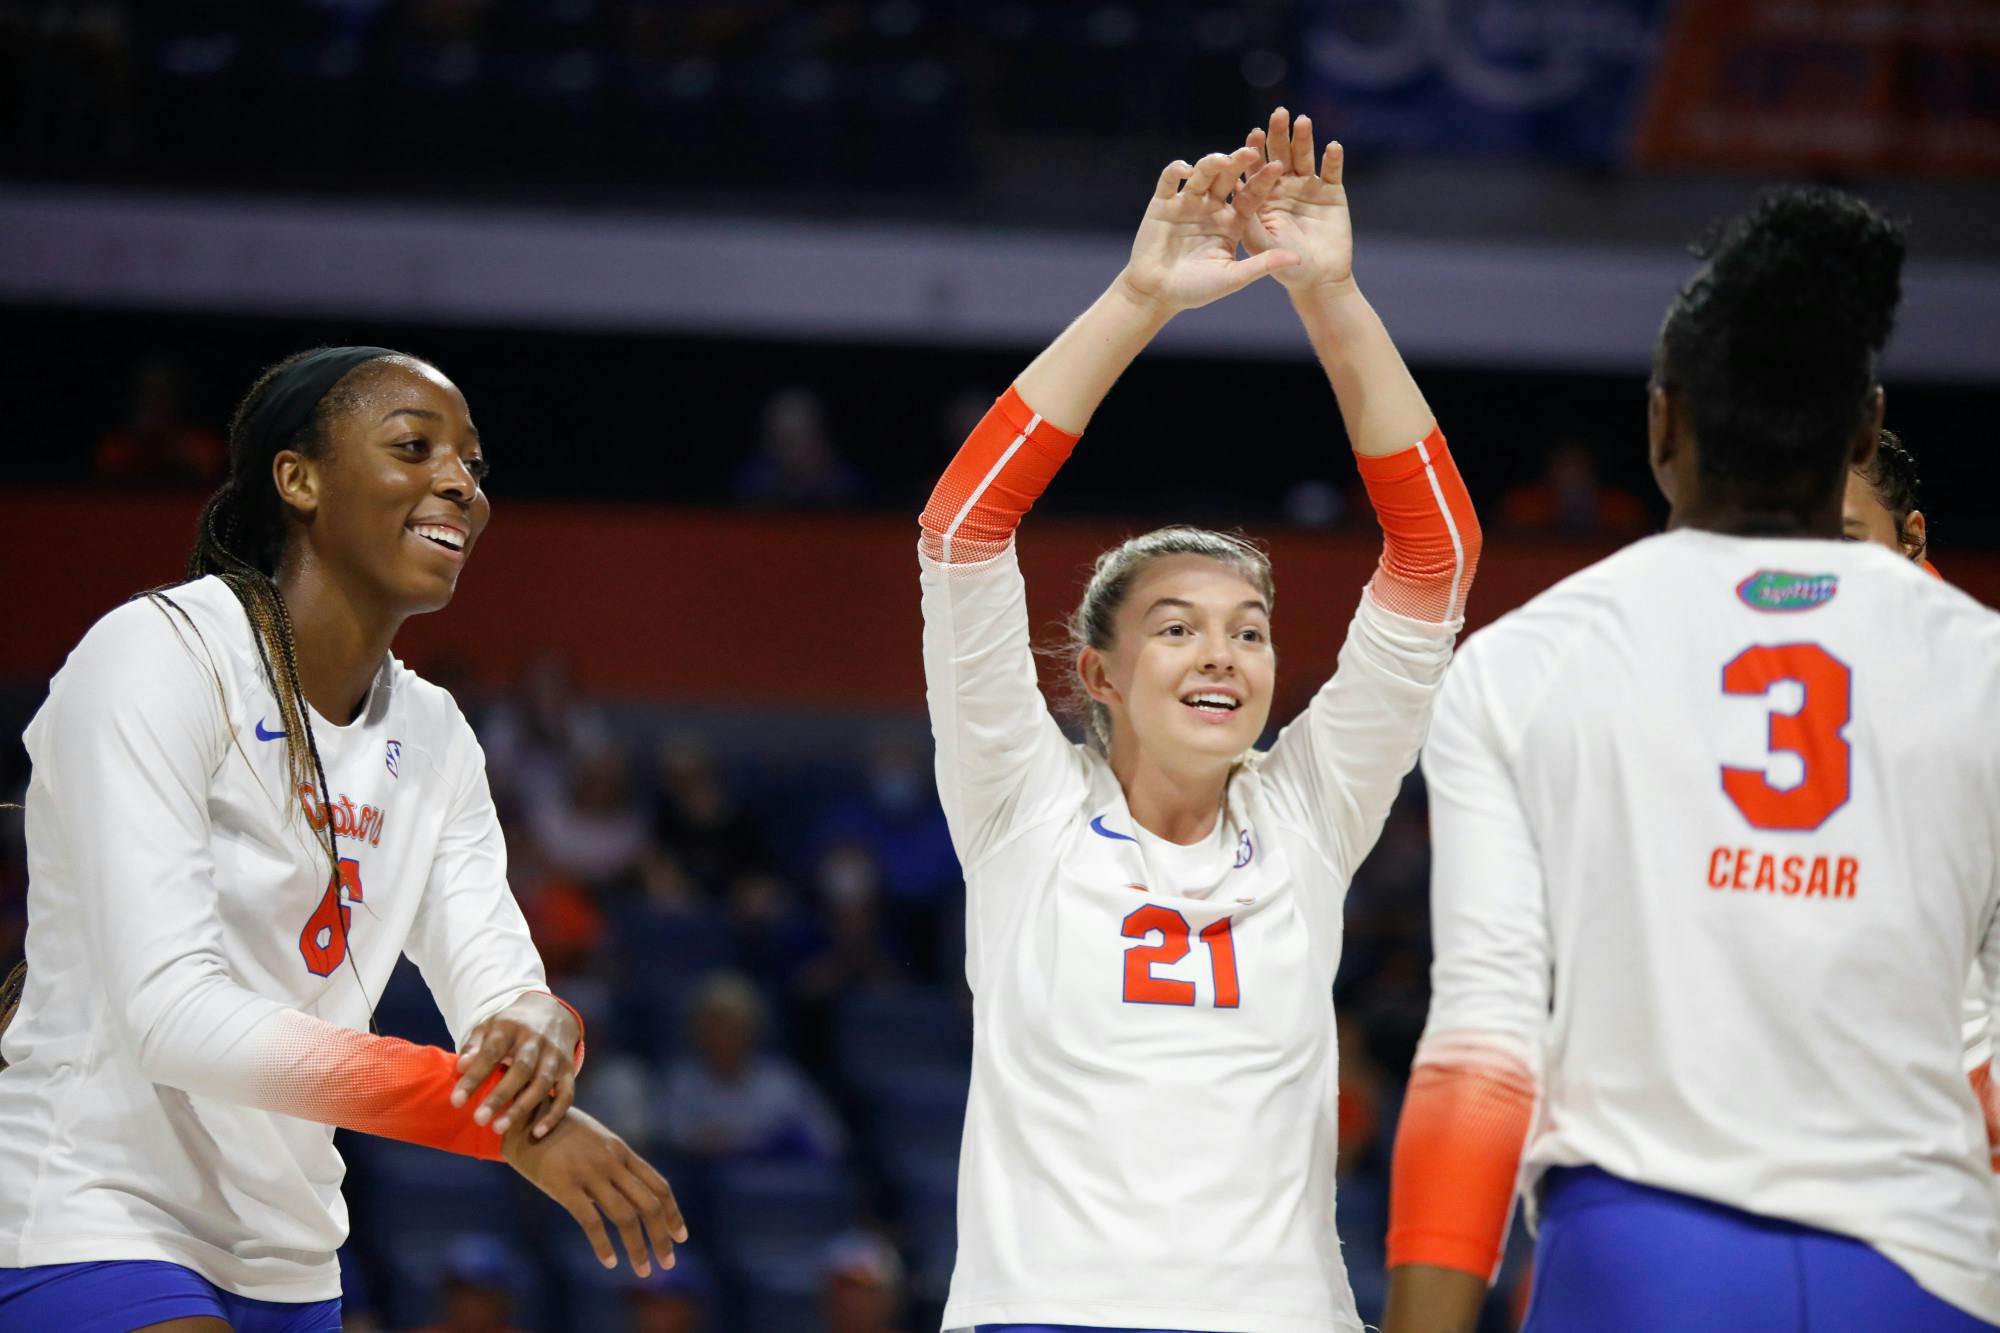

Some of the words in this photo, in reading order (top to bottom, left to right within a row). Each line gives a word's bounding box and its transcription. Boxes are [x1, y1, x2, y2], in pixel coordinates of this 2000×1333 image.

[1720, 641, 1853, 833] 3
[299, 857, 364, 978] 6
[1706, 846, 1861, 900] CEASAR
[1120, 903, 1240, 1009] 21
